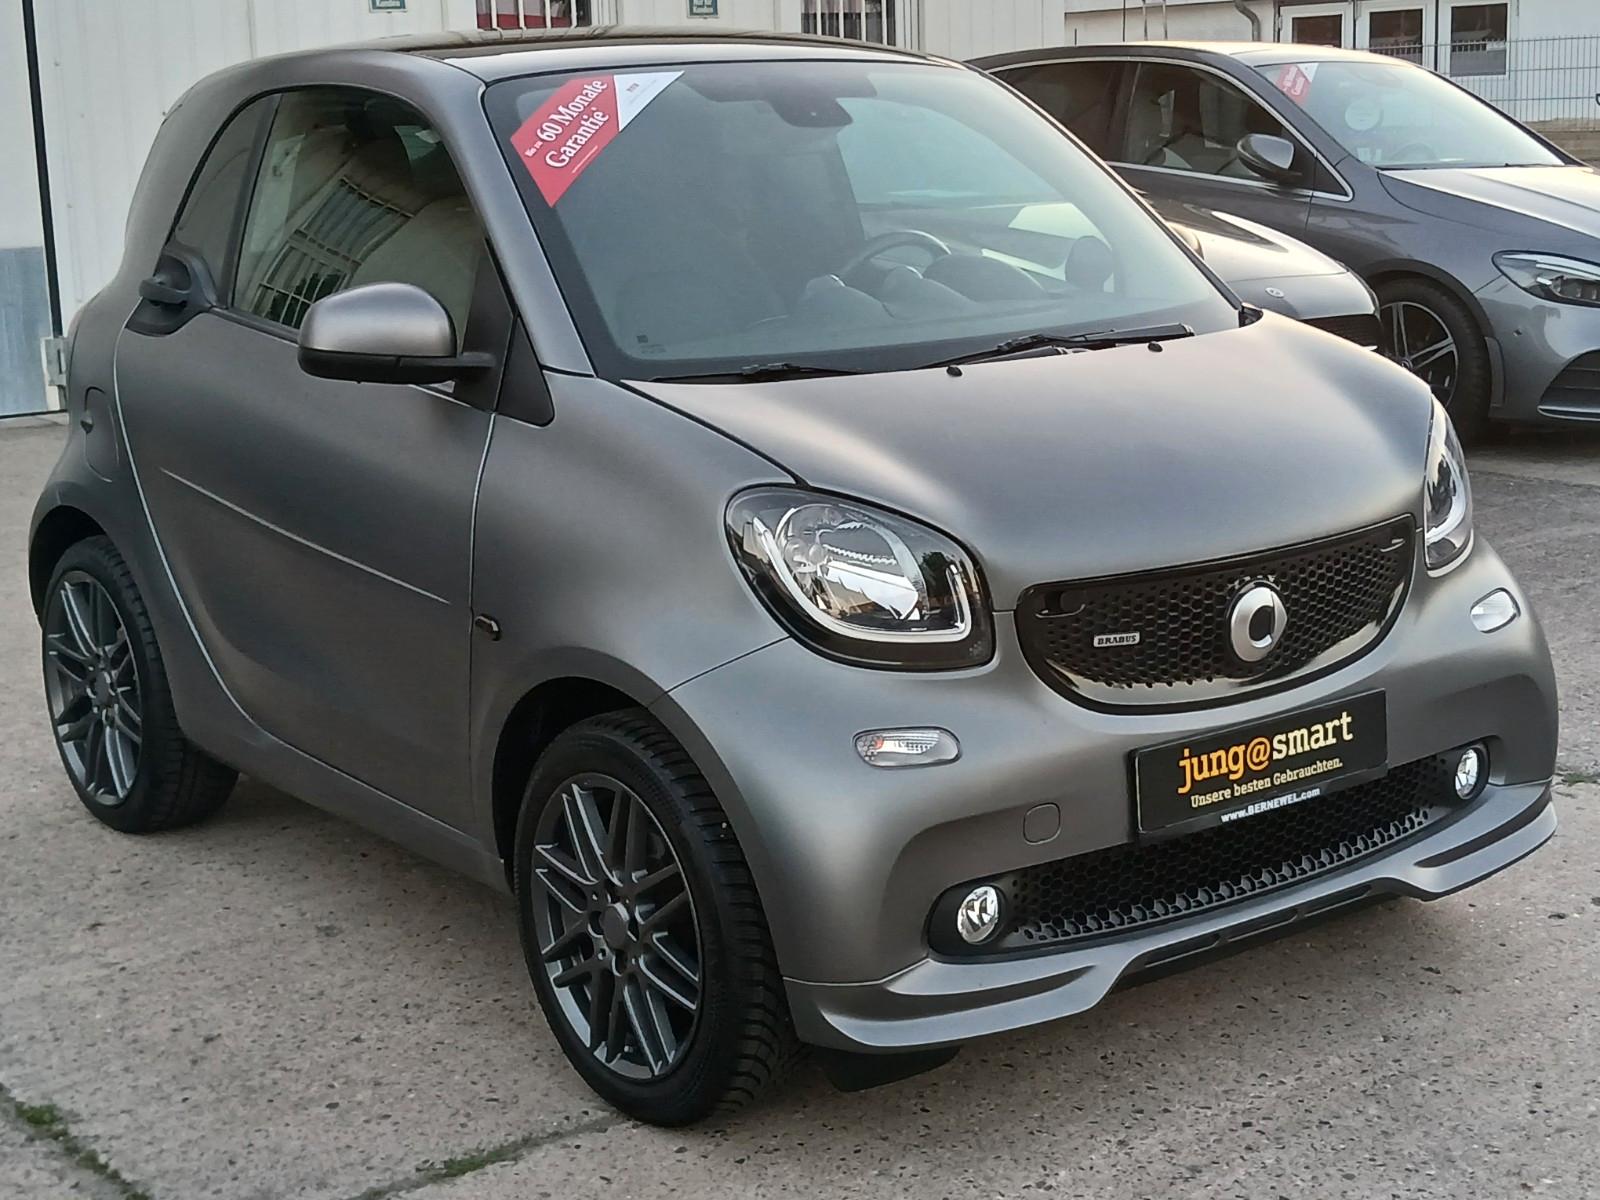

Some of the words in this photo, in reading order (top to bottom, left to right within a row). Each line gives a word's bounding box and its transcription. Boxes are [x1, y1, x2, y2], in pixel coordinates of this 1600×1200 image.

[549, 79, 608, 126] Monate
[536, 121, 563, 142] 60
[1097, 635, 1136, 645] BRABUS
[1177, 711, 1354, 794] jung@smart
[1190, 788, 1232, 808] Unsere
[1234, 776, 1271, 797] besten
[1273, 757, 1343, 785] Gebrauchten.
[1220, 787, 1321, 823] www.BERNEWEL.com
